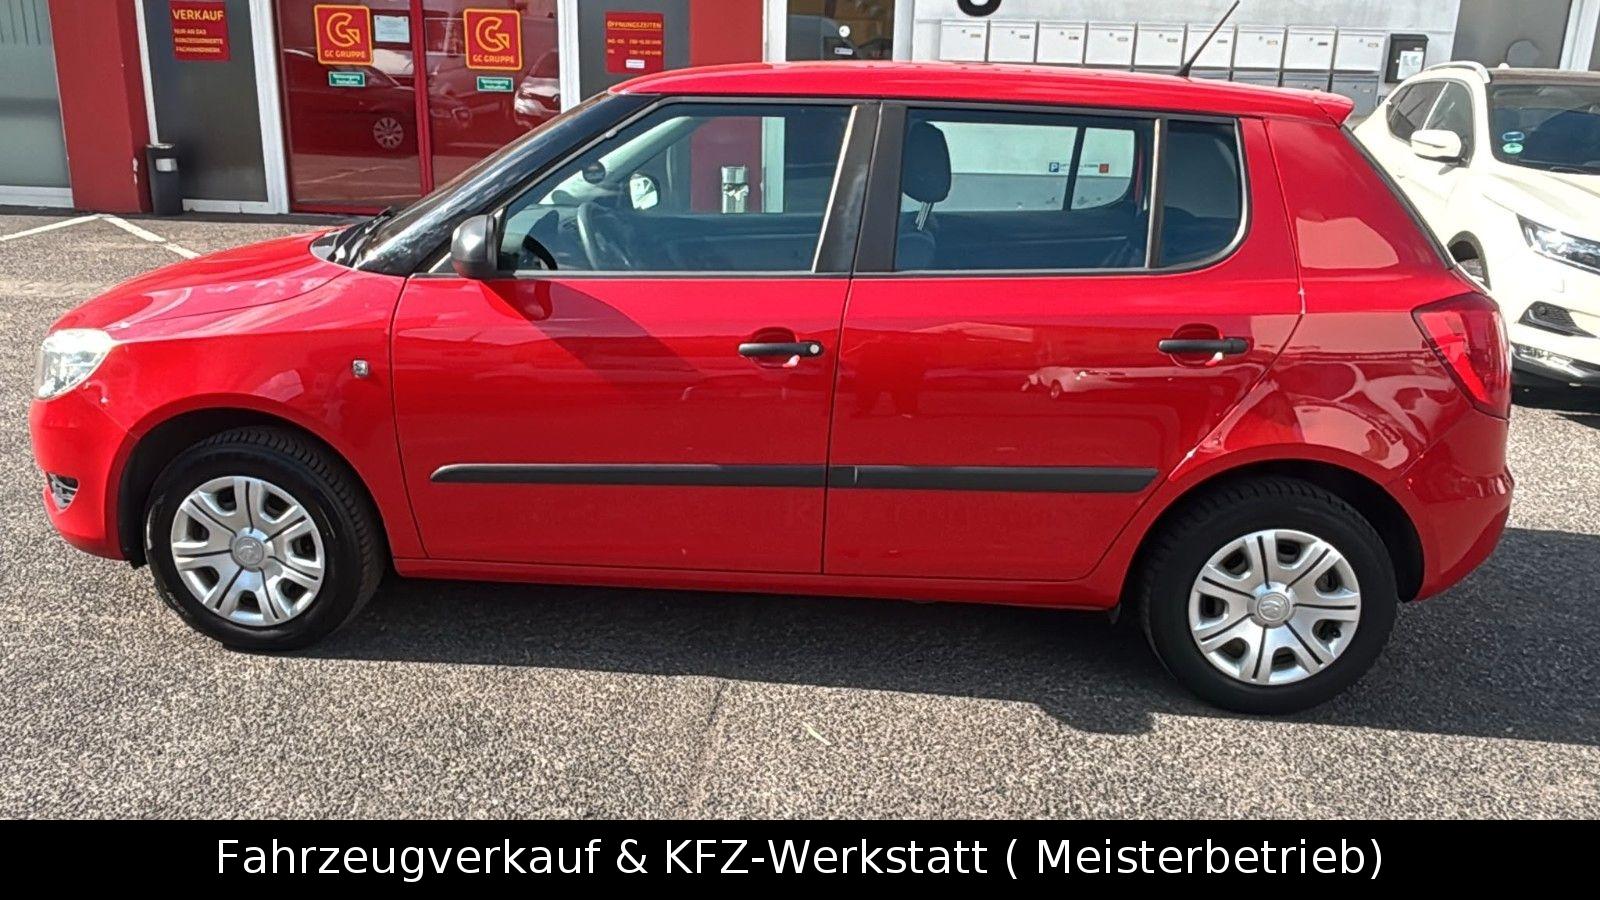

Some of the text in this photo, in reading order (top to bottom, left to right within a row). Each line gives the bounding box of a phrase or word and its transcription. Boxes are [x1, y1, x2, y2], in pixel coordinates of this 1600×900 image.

[171, 9, 224, 21] VERKAUF
[324, 50, 367, 59] GC GRUPPE
[472, 54, 515, 64] GC GRUPPE
